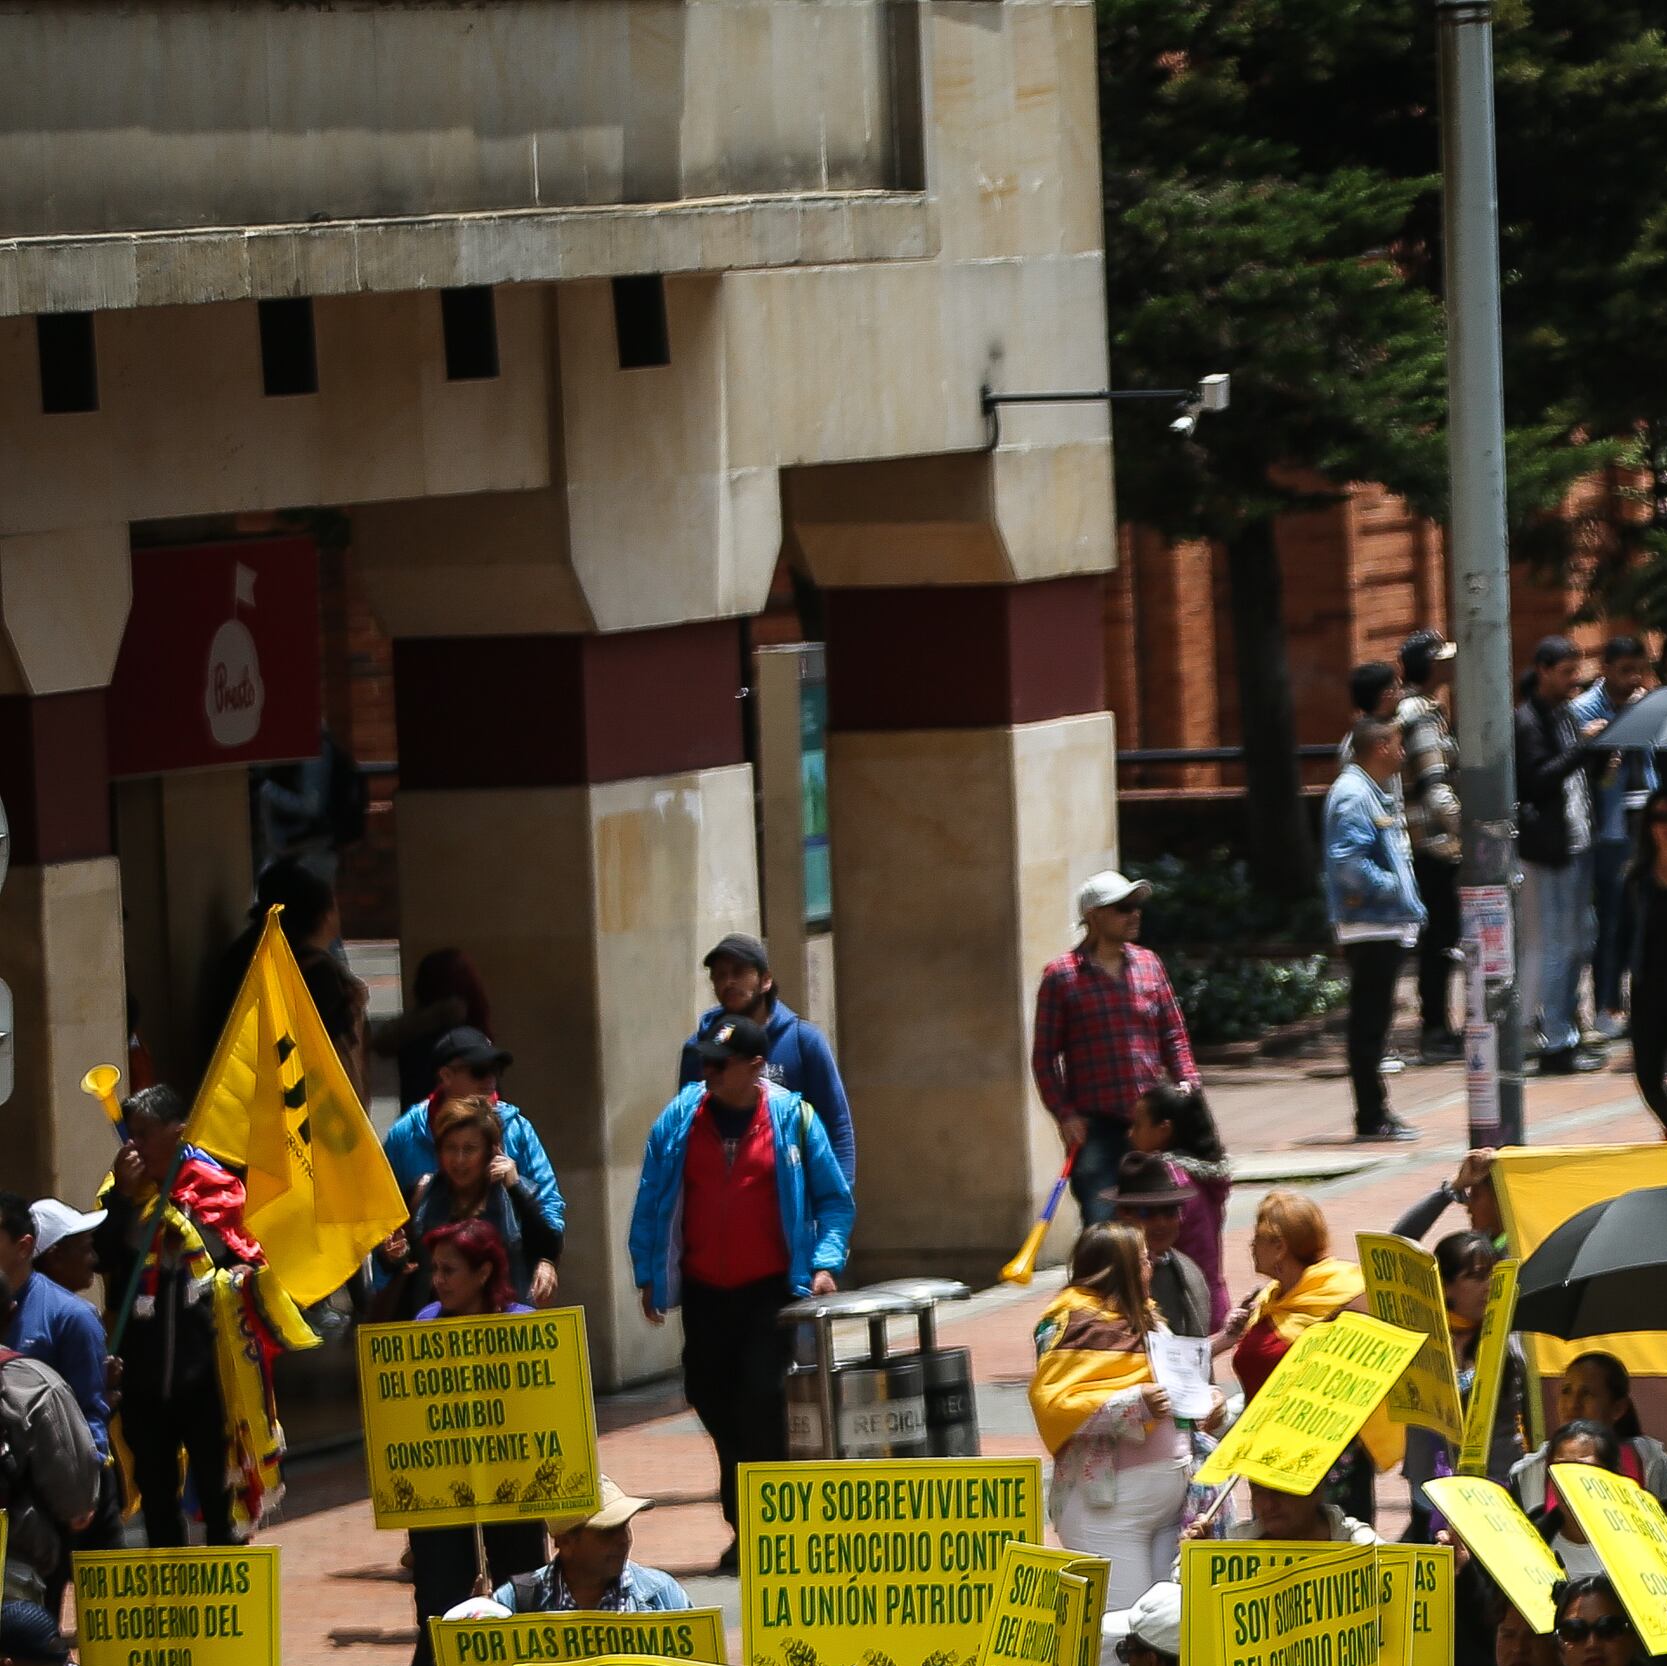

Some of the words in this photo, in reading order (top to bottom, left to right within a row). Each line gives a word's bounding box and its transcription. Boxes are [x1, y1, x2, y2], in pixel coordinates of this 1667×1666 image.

[371, 1336, 404, 1363] POR
[410, 1330, 445, 1360] LAS
[449, 1322, 559, 1357] REFORMAS
[379, 1371, 410, 1399] DEL
[414, 1362, 510, 1396] GOBIERNO
[517, 1360, 556, 1387] DEL
[428, 1399, 505, 1431] CAMBIO
[387, 1432, 530, 1470] CONSTITUYENTE
[534, 1430, 563, 1457] YA
